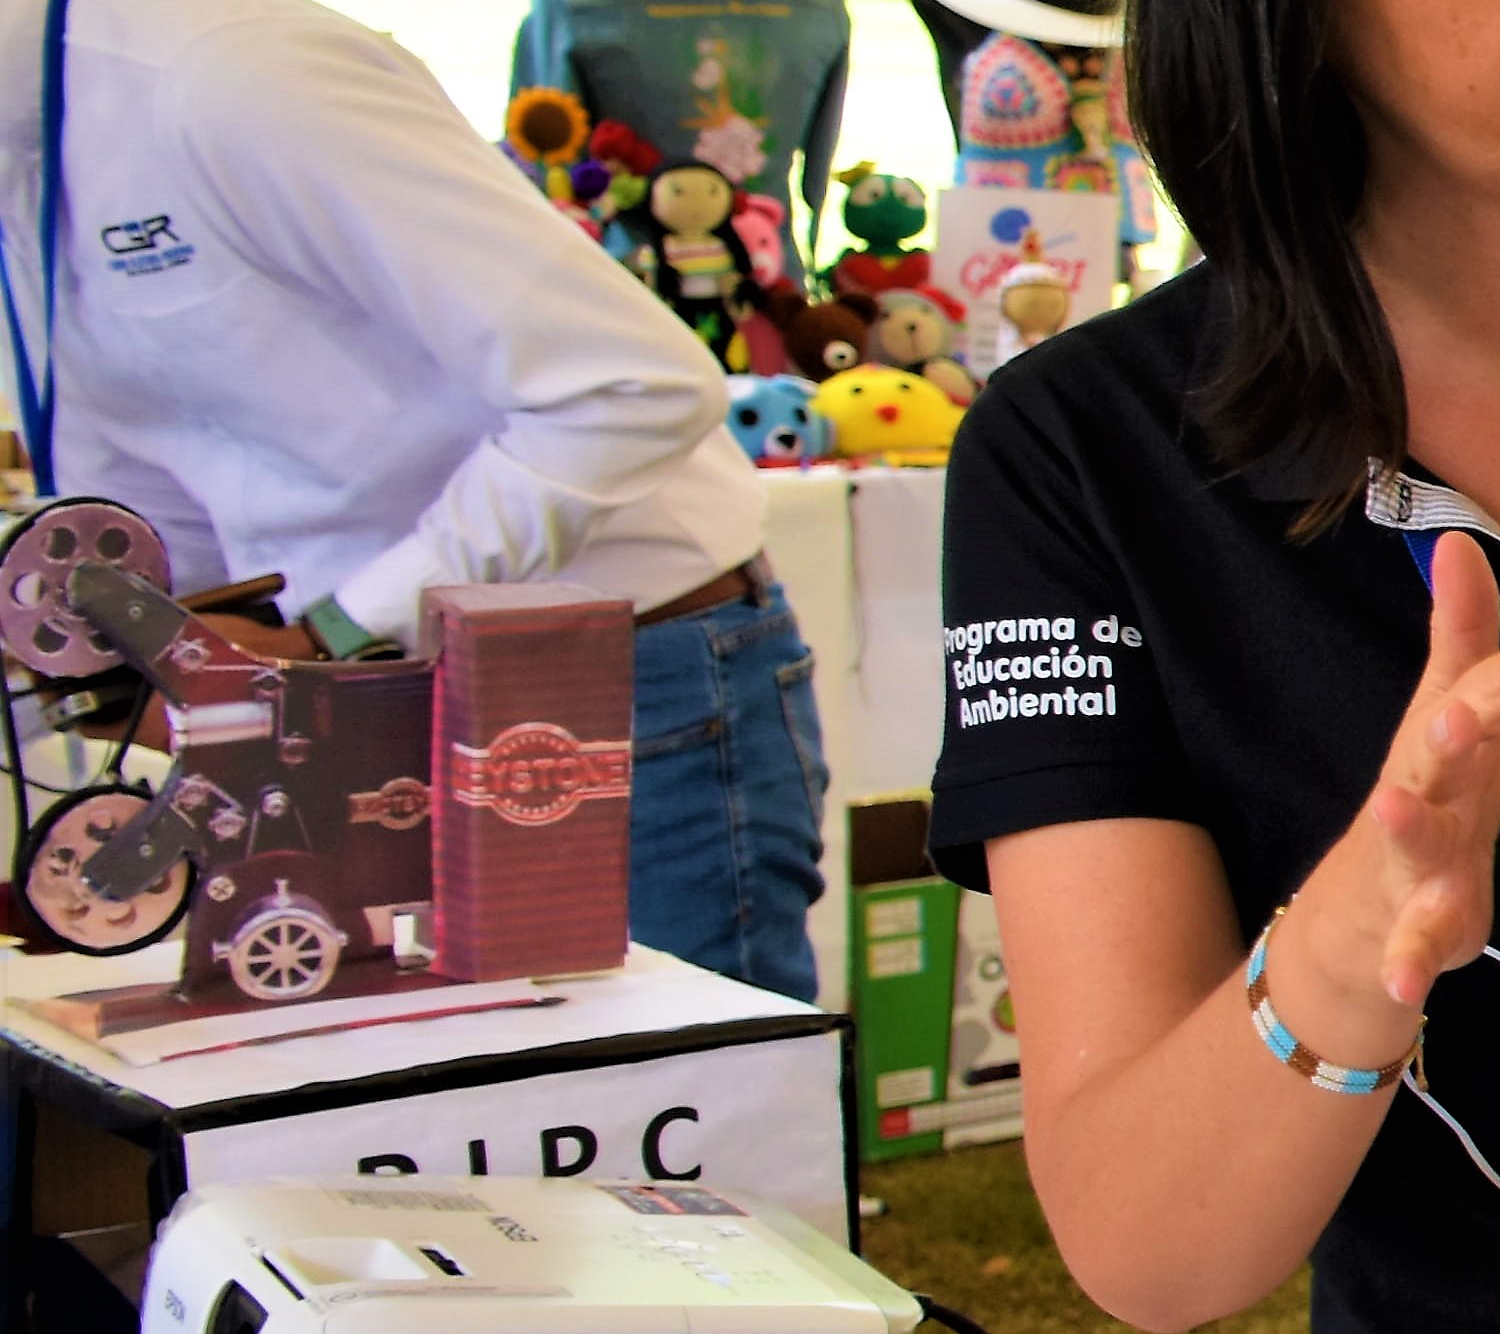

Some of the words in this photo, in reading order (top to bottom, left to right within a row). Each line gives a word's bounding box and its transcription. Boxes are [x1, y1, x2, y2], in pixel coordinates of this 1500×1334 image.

[1092, 615, 1143, 647] de
[952, 645, 1112, 691] Educación
[959, 684, 1116, 729] Ambiental
